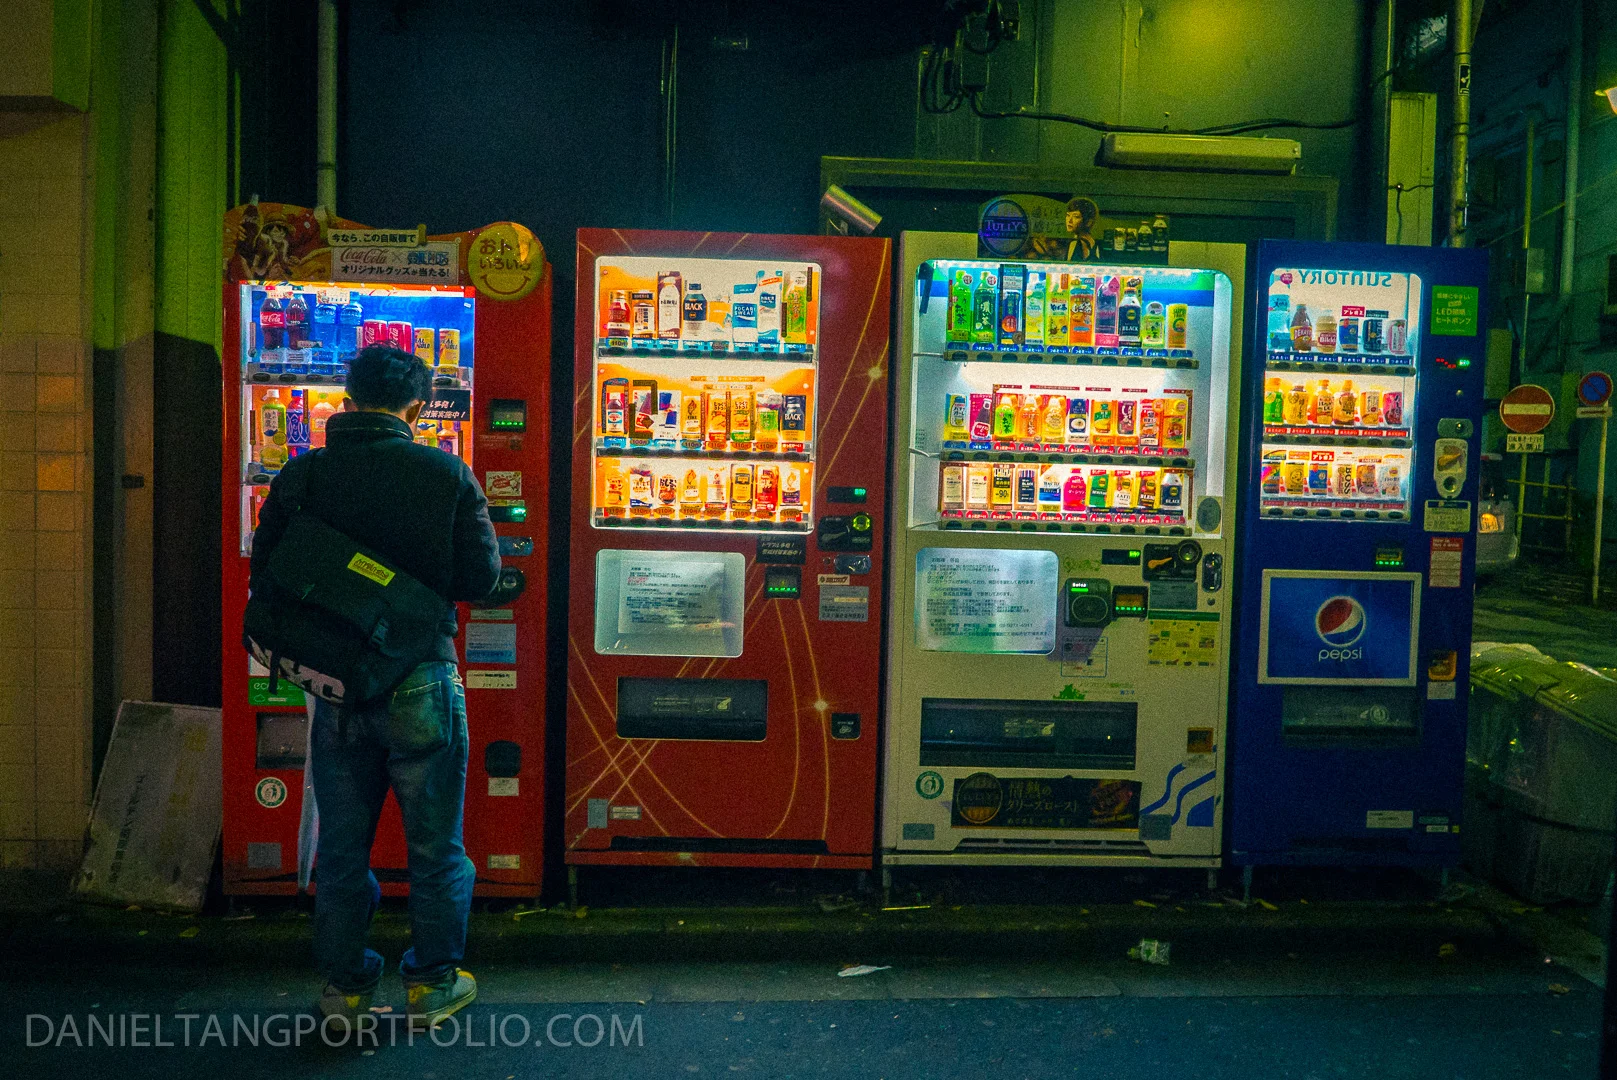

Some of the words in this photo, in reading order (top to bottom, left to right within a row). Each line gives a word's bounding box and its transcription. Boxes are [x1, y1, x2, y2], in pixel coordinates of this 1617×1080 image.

[685, 303, 703, 311] BLACK
[980, 300, 992, 326] 濃い茶
[784, 413, 801, 421] BLACK
[1508, 443, 1542, 451] 進入禁止
[1344, 466, 1352, 495] BOSS
[1318, 646, 1363, 662] pepsi
